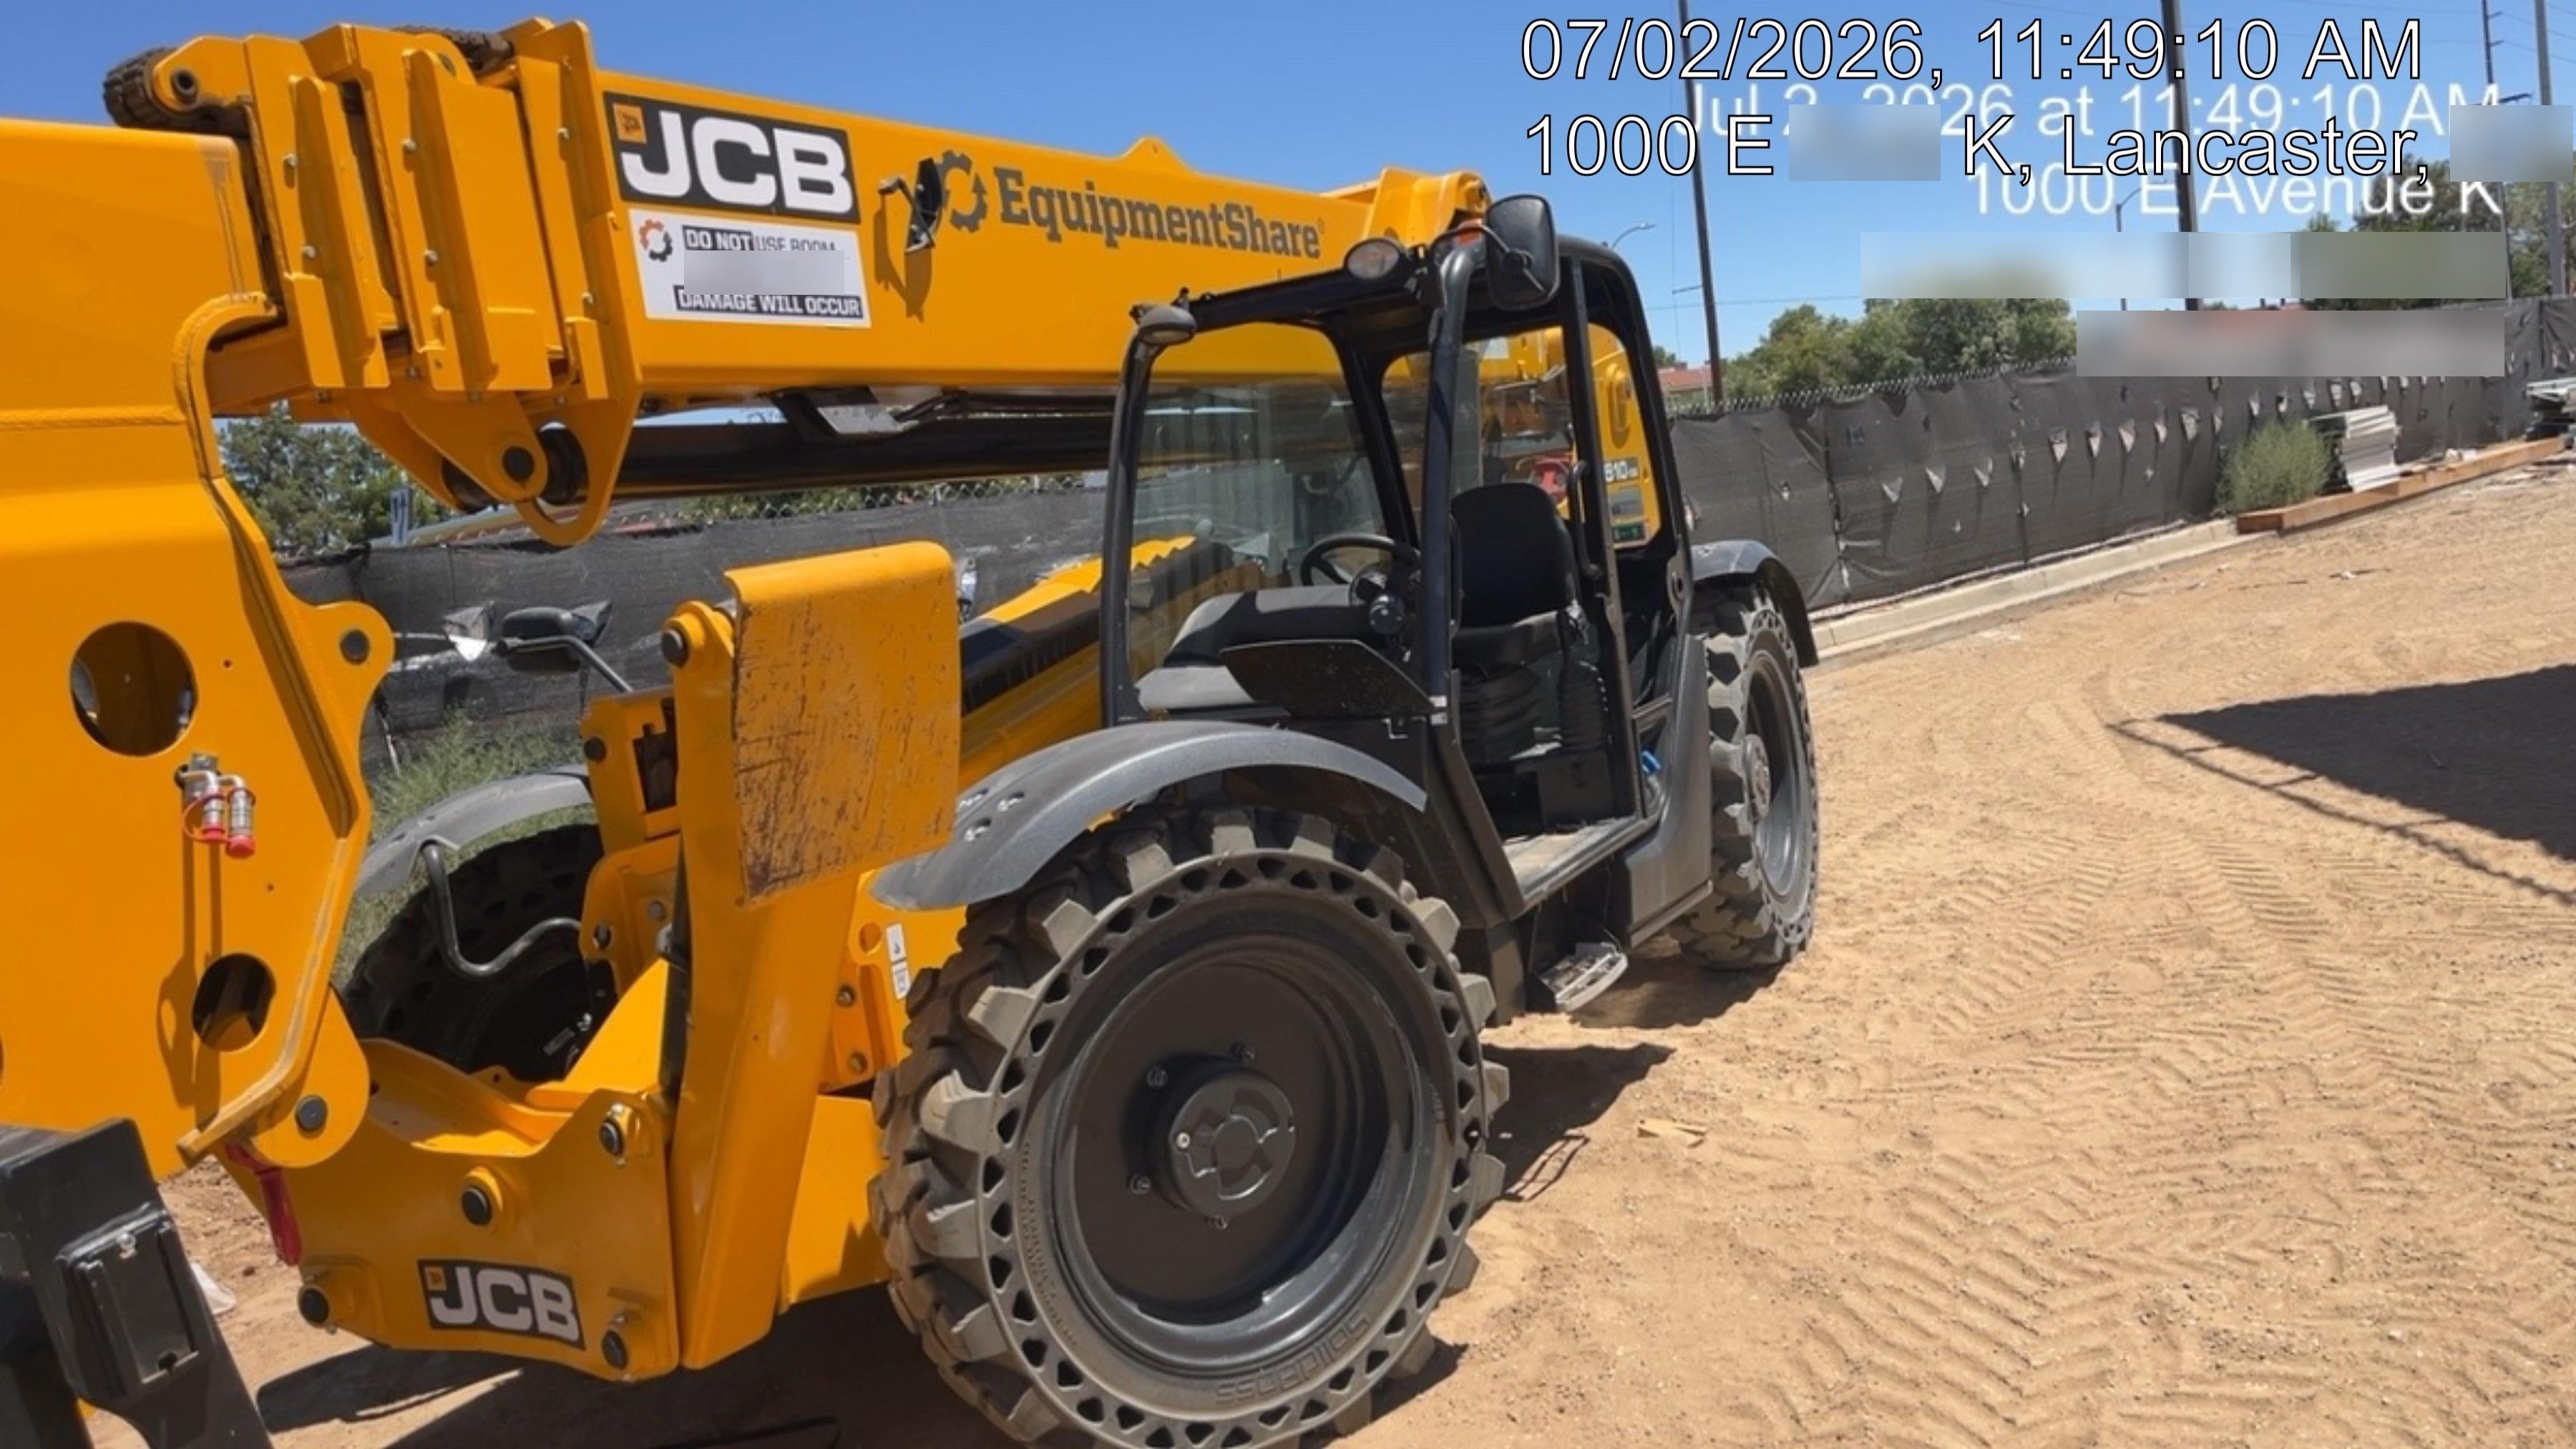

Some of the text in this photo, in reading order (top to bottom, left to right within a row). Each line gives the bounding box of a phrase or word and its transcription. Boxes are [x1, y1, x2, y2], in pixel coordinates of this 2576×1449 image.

[620, 110, 854, 213] JCB
[685, 228, 713, 250] DO
[716, 230, 751, 251] NOT
[994, 167, 1321, 259] EquipmentShare
[680, 288, 859, 316] DAMAGE WILL OCCUR
[429, 1266, 580, 1342] JCB
